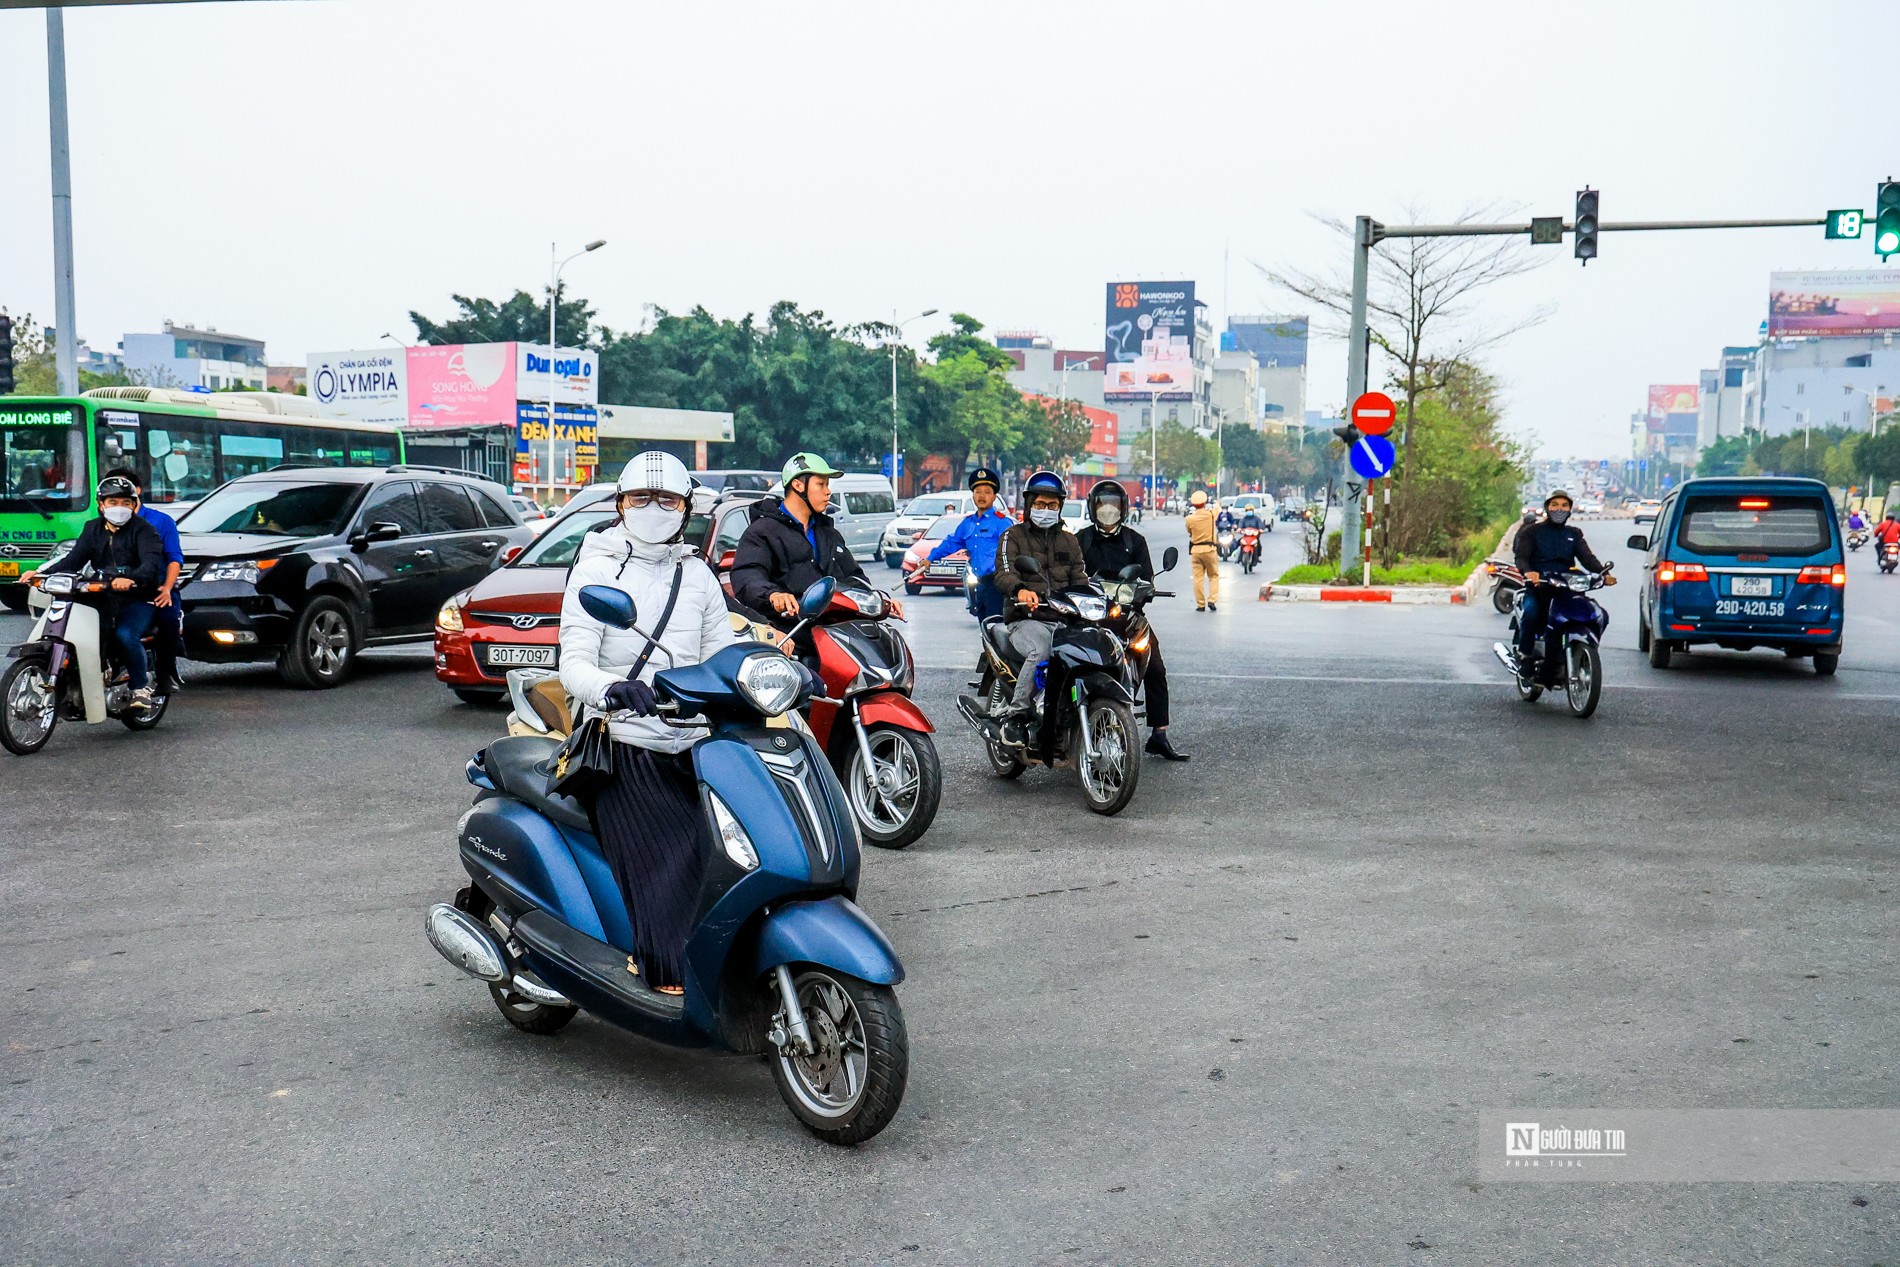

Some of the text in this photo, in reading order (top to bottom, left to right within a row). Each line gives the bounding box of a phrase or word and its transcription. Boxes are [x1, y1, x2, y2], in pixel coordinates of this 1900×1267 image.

[1838, 211, 1860, 237] 18
[1139, 292, 1186, 300] HAWONKOO
[357, 360, 366, 368] GA
[18, 412, 50, 425] LONG
[554, 424, 597, 443] XANH
[12, 531, 33, 540] CNG
[36, 531, 56, 540] BUS
[1743, 577, 1760, 586] 29D
[1736, 586, 1767, 595] 420.58
[1716, 600, 1785, 616] 29D-420.58
[493, 649, 550, 662] 30T-7097
